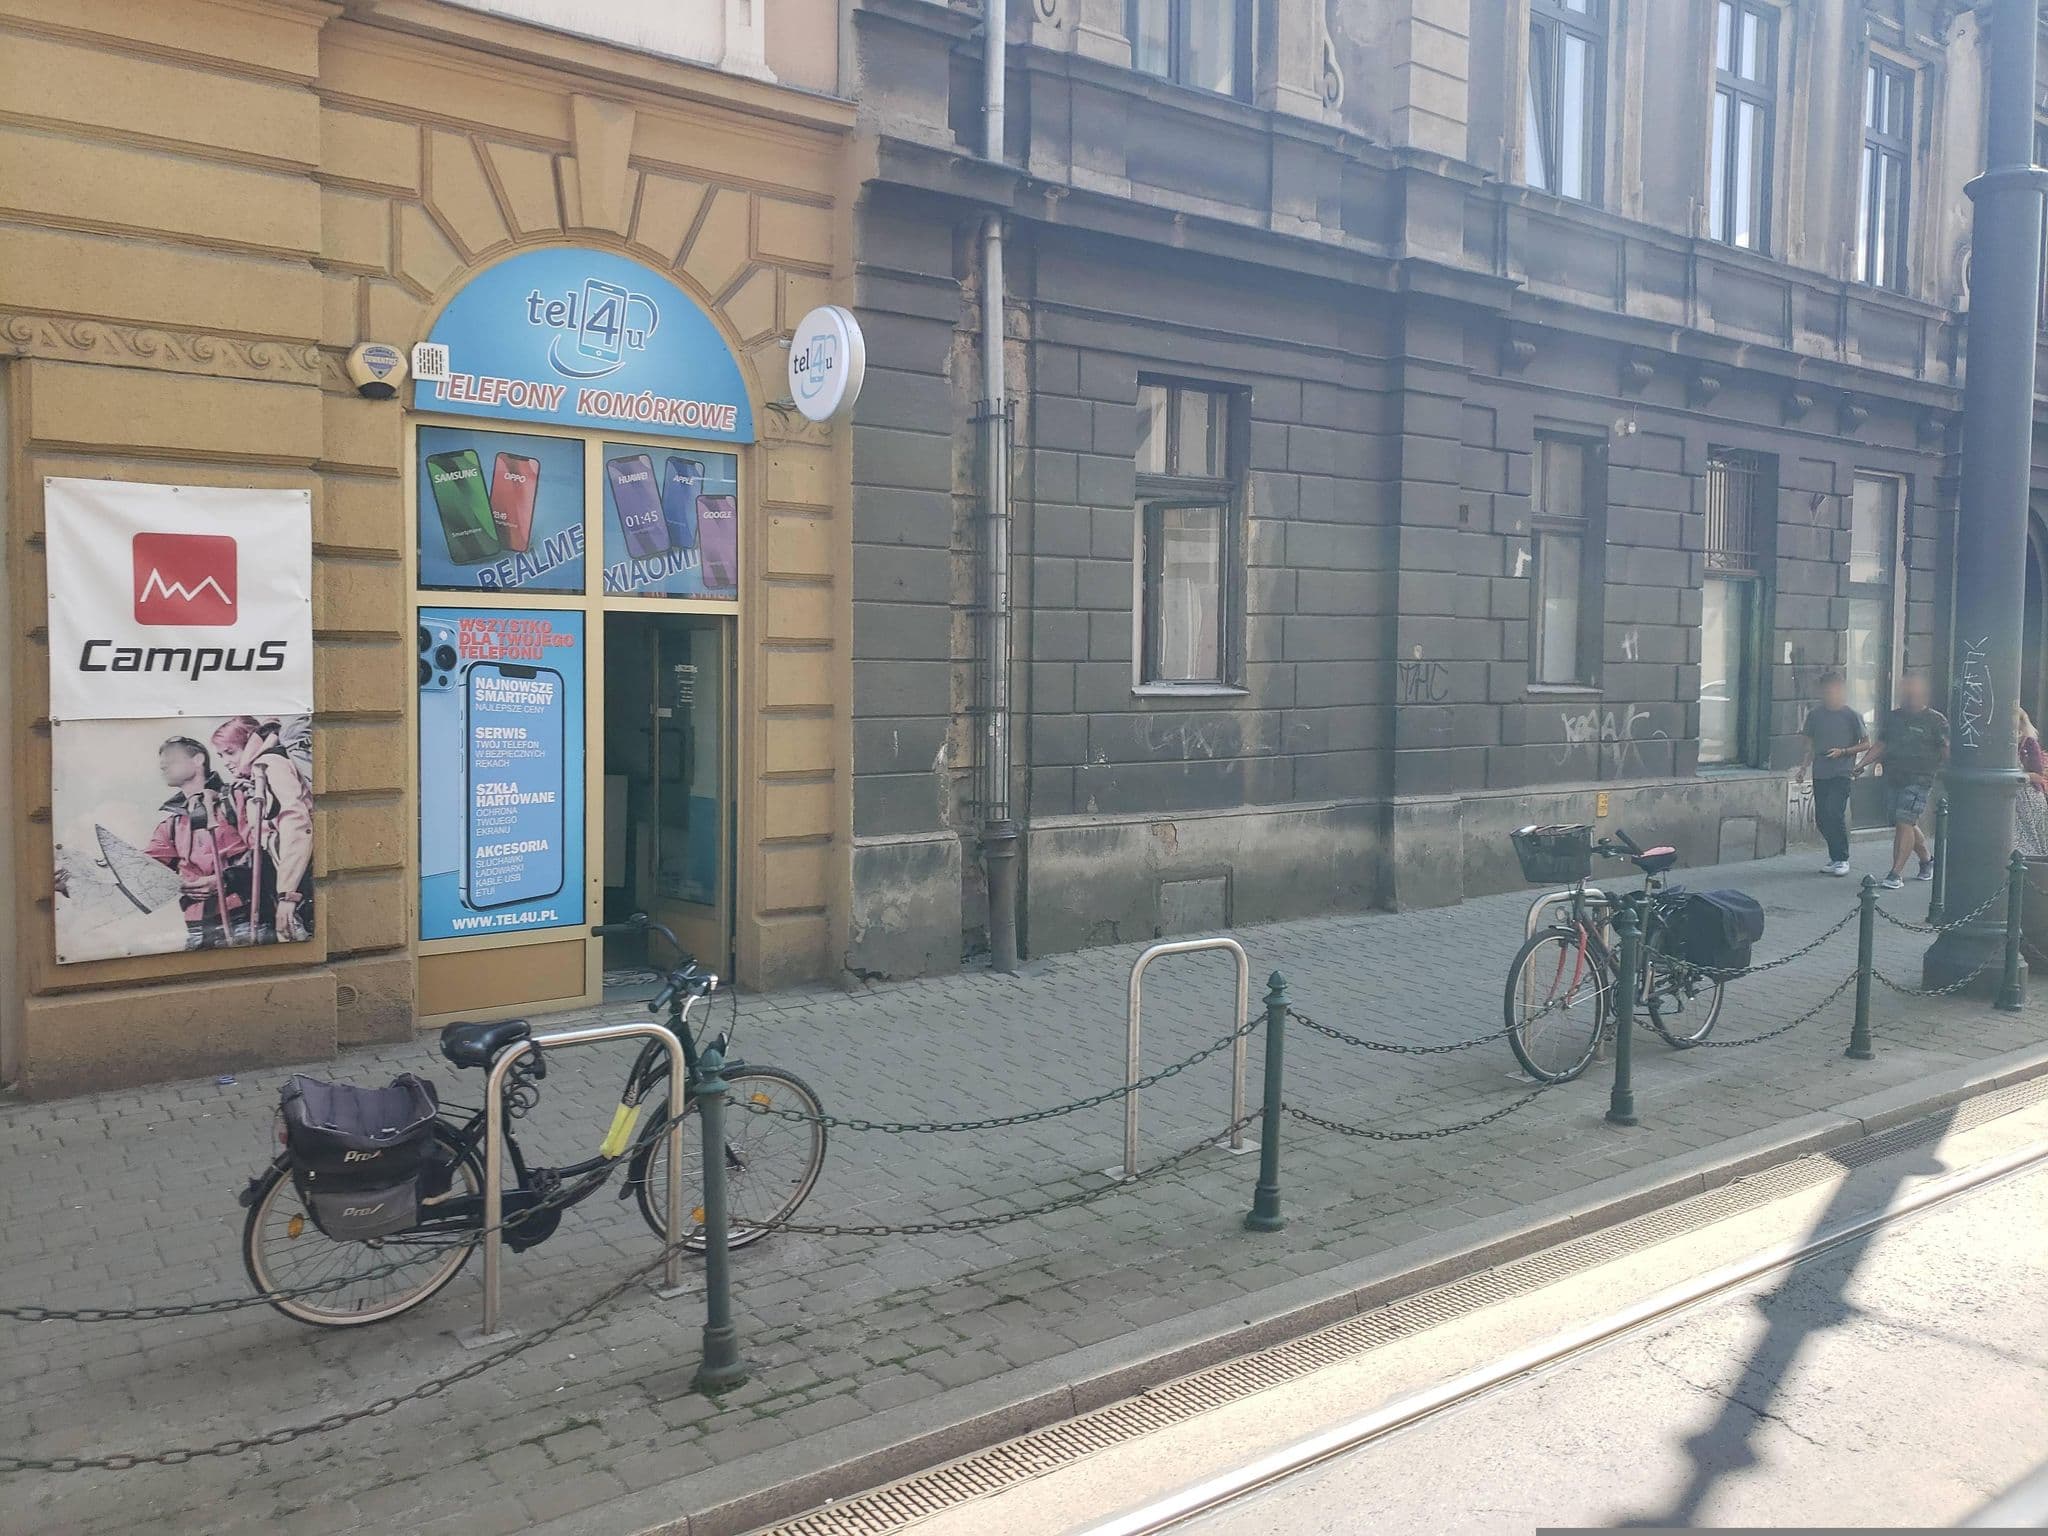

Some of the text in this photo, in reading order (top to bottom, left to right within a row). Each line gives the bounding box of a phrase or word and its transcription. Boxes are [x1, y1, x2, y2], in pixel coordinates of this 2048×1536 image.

[576, 388, 738, 432] KOMÓRKOWE
[434, 468, 479, 484] SAMSUNG
[503, 472, 527, 483] OPPO
[618, 472, 648, 485] HUAWEI
[672, 475, 695, 486] APPLE
[625, 511, 659, 528] 01:45
[703, 510, 733, 520] GOOGLE
[478, 523, 585, 590] REALME
[458, 618, 553, 634] WSZYSTKO
[458, 632, 575, 648] DLA TWOJEGO
[459, 645, 544, 660] TELEFONU
[79, 639, 288, 682] CampuS
[475, 677, 554, 694] NAJNOWSZE
[475, 690, 554, 705] SMARTFONY
[475, 727, 527, 740] SERWIS
[502, 741, 539, 749] TELEFON
[476, 782, 519, 796] SZKŁA
[476, 791, 556, 808] HARTOWANE
[476, 806, 518, 817] OCHRONA
[476, 816, 518, 827] TWOJEGO
[476, 825, 511, 837] EKRANU
[475, 839, 549, 859] AKCESORIA
[452, 909, 559, 931] WWW.TEL4U.PL
